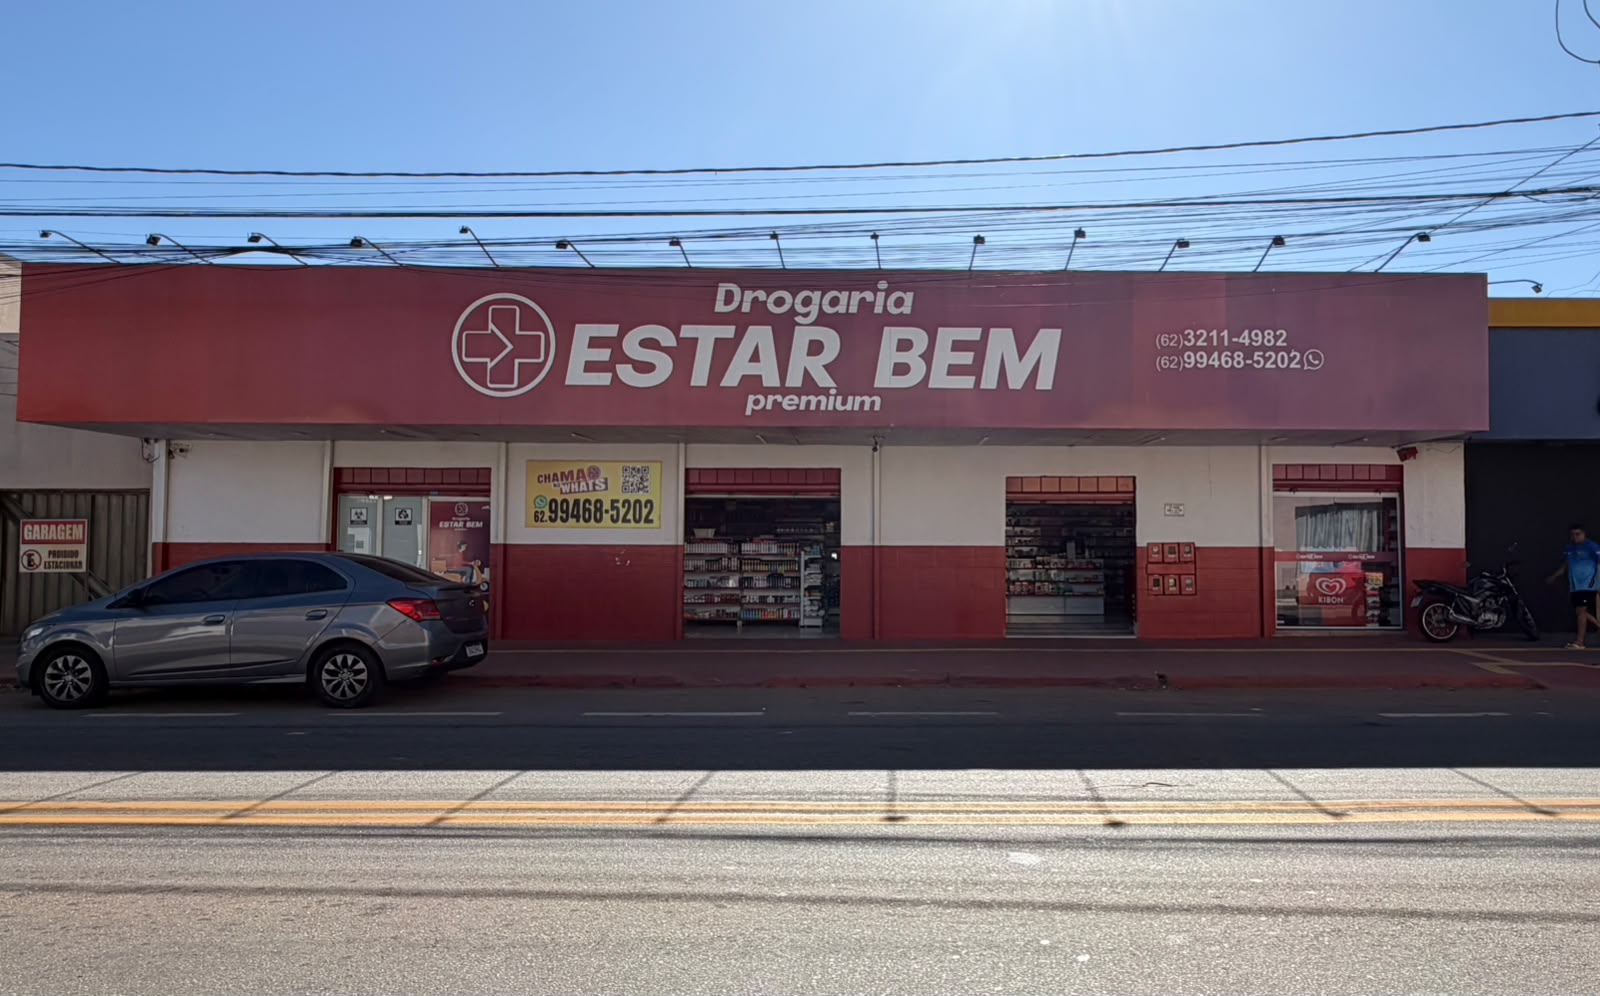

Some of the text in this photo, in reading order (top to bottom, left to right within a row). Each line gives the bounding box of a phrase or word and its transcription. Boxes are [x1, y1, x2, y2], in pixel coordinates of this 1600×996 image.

[714, 281, 915, 325] Drogaria
[1155, 329, 1288, 350] (62)3211-4982
[565, 323, 1062, 391] ESTAR BEM
[1155, 351, 1301, 372] (62)99468-5202
[745, 388, 882, 416] premium
[537, 467, 588, 484] CHAMA
[561, 477, 607, 494] WHATS
[23, 523, 83, 541] GARAGEM
[1318, 596, 1344, 604] KIBON
